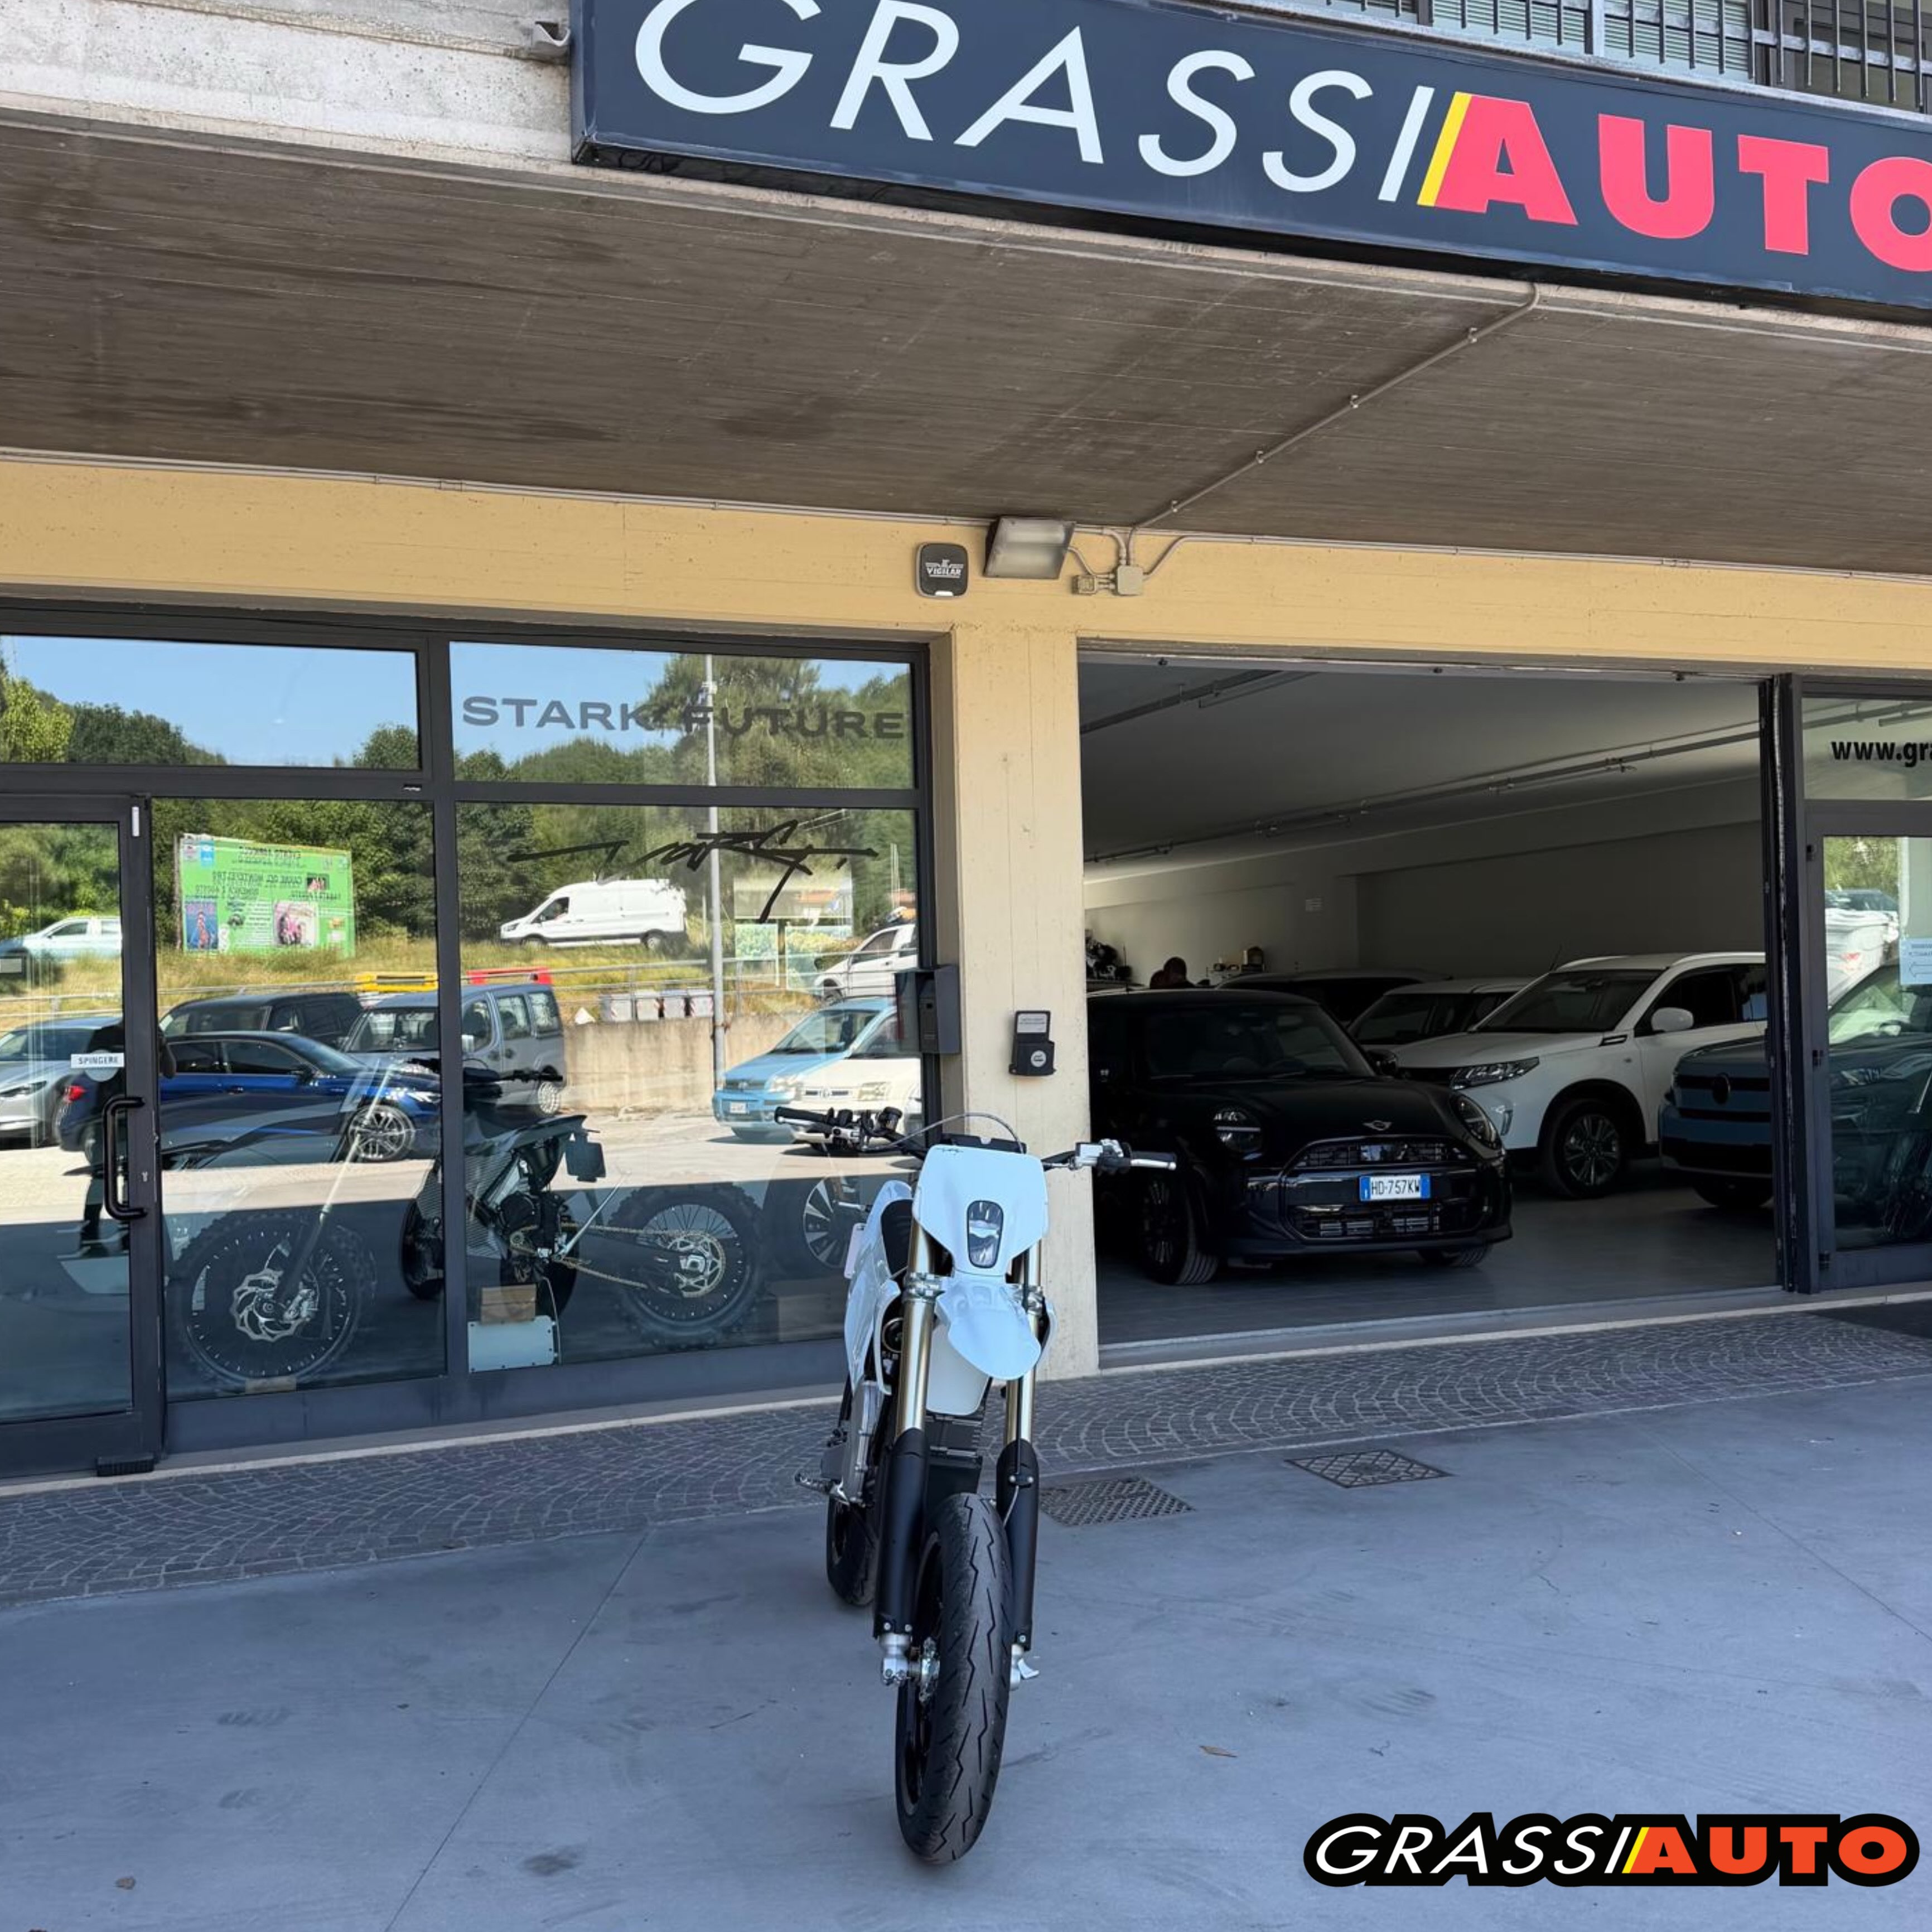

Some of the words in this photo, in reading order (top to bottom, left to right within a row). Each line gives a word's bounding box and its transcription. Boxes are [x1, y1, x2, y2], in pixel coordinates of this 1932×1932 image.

[462, 695, 655, 732] STARK
[685, 706, 905, 740] FUTURE
[1831, 741, 1932, 767] www.gr
